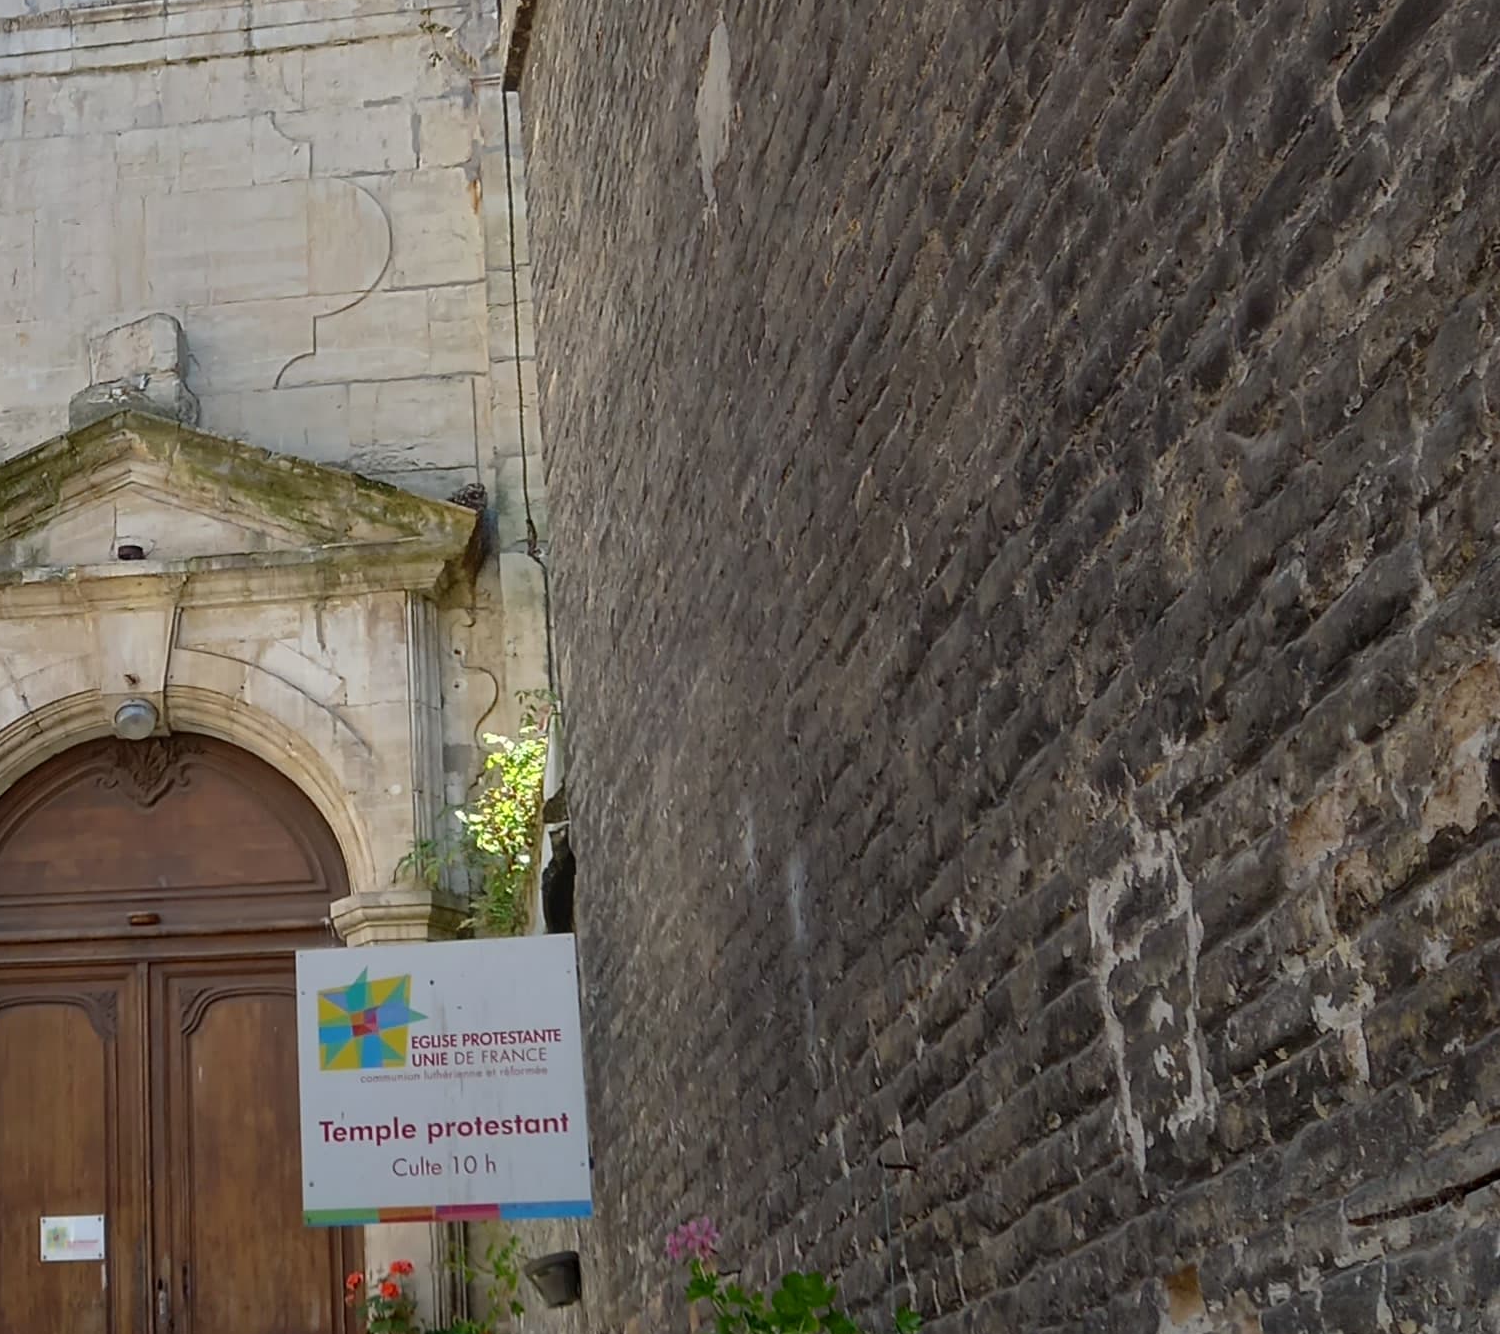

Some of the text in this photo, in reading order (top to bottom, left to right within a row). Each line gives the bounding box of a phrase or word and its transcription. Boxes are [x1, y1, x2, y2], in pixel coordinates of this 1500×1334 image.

[411, 1028, 561, 1048] EGLISE PROTESTANTE
[412, 1047, 547, 1067] UNIE DE FRANCE
[360, 1072, 420, 1083] communion
[423, 1068, 482, 1080] luthérienne
[485, 1069, 496, 1077] et
[319, 1112, 568, 1146] Temple protestant
[392, 1154, 496, 1177] Culte 10 h
